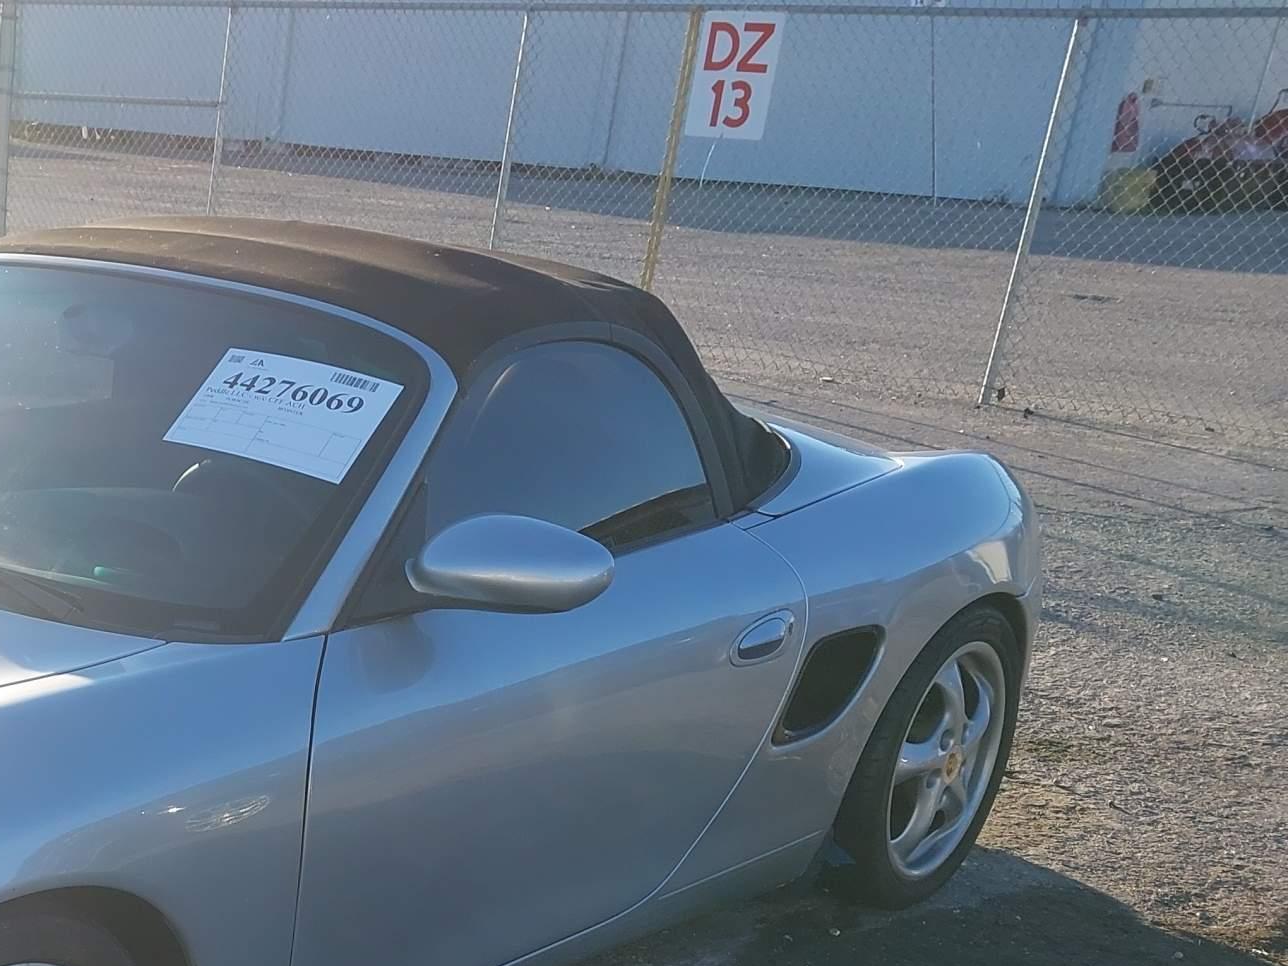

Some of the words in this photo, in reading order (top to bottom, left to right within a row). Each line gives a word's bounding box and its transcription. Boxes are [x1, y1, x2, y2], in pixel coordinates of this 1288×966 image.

[703, 21, 776, 73] DZ
[709, 79, 753, 128] 13
[222, 371, 364, 414] 44276069
